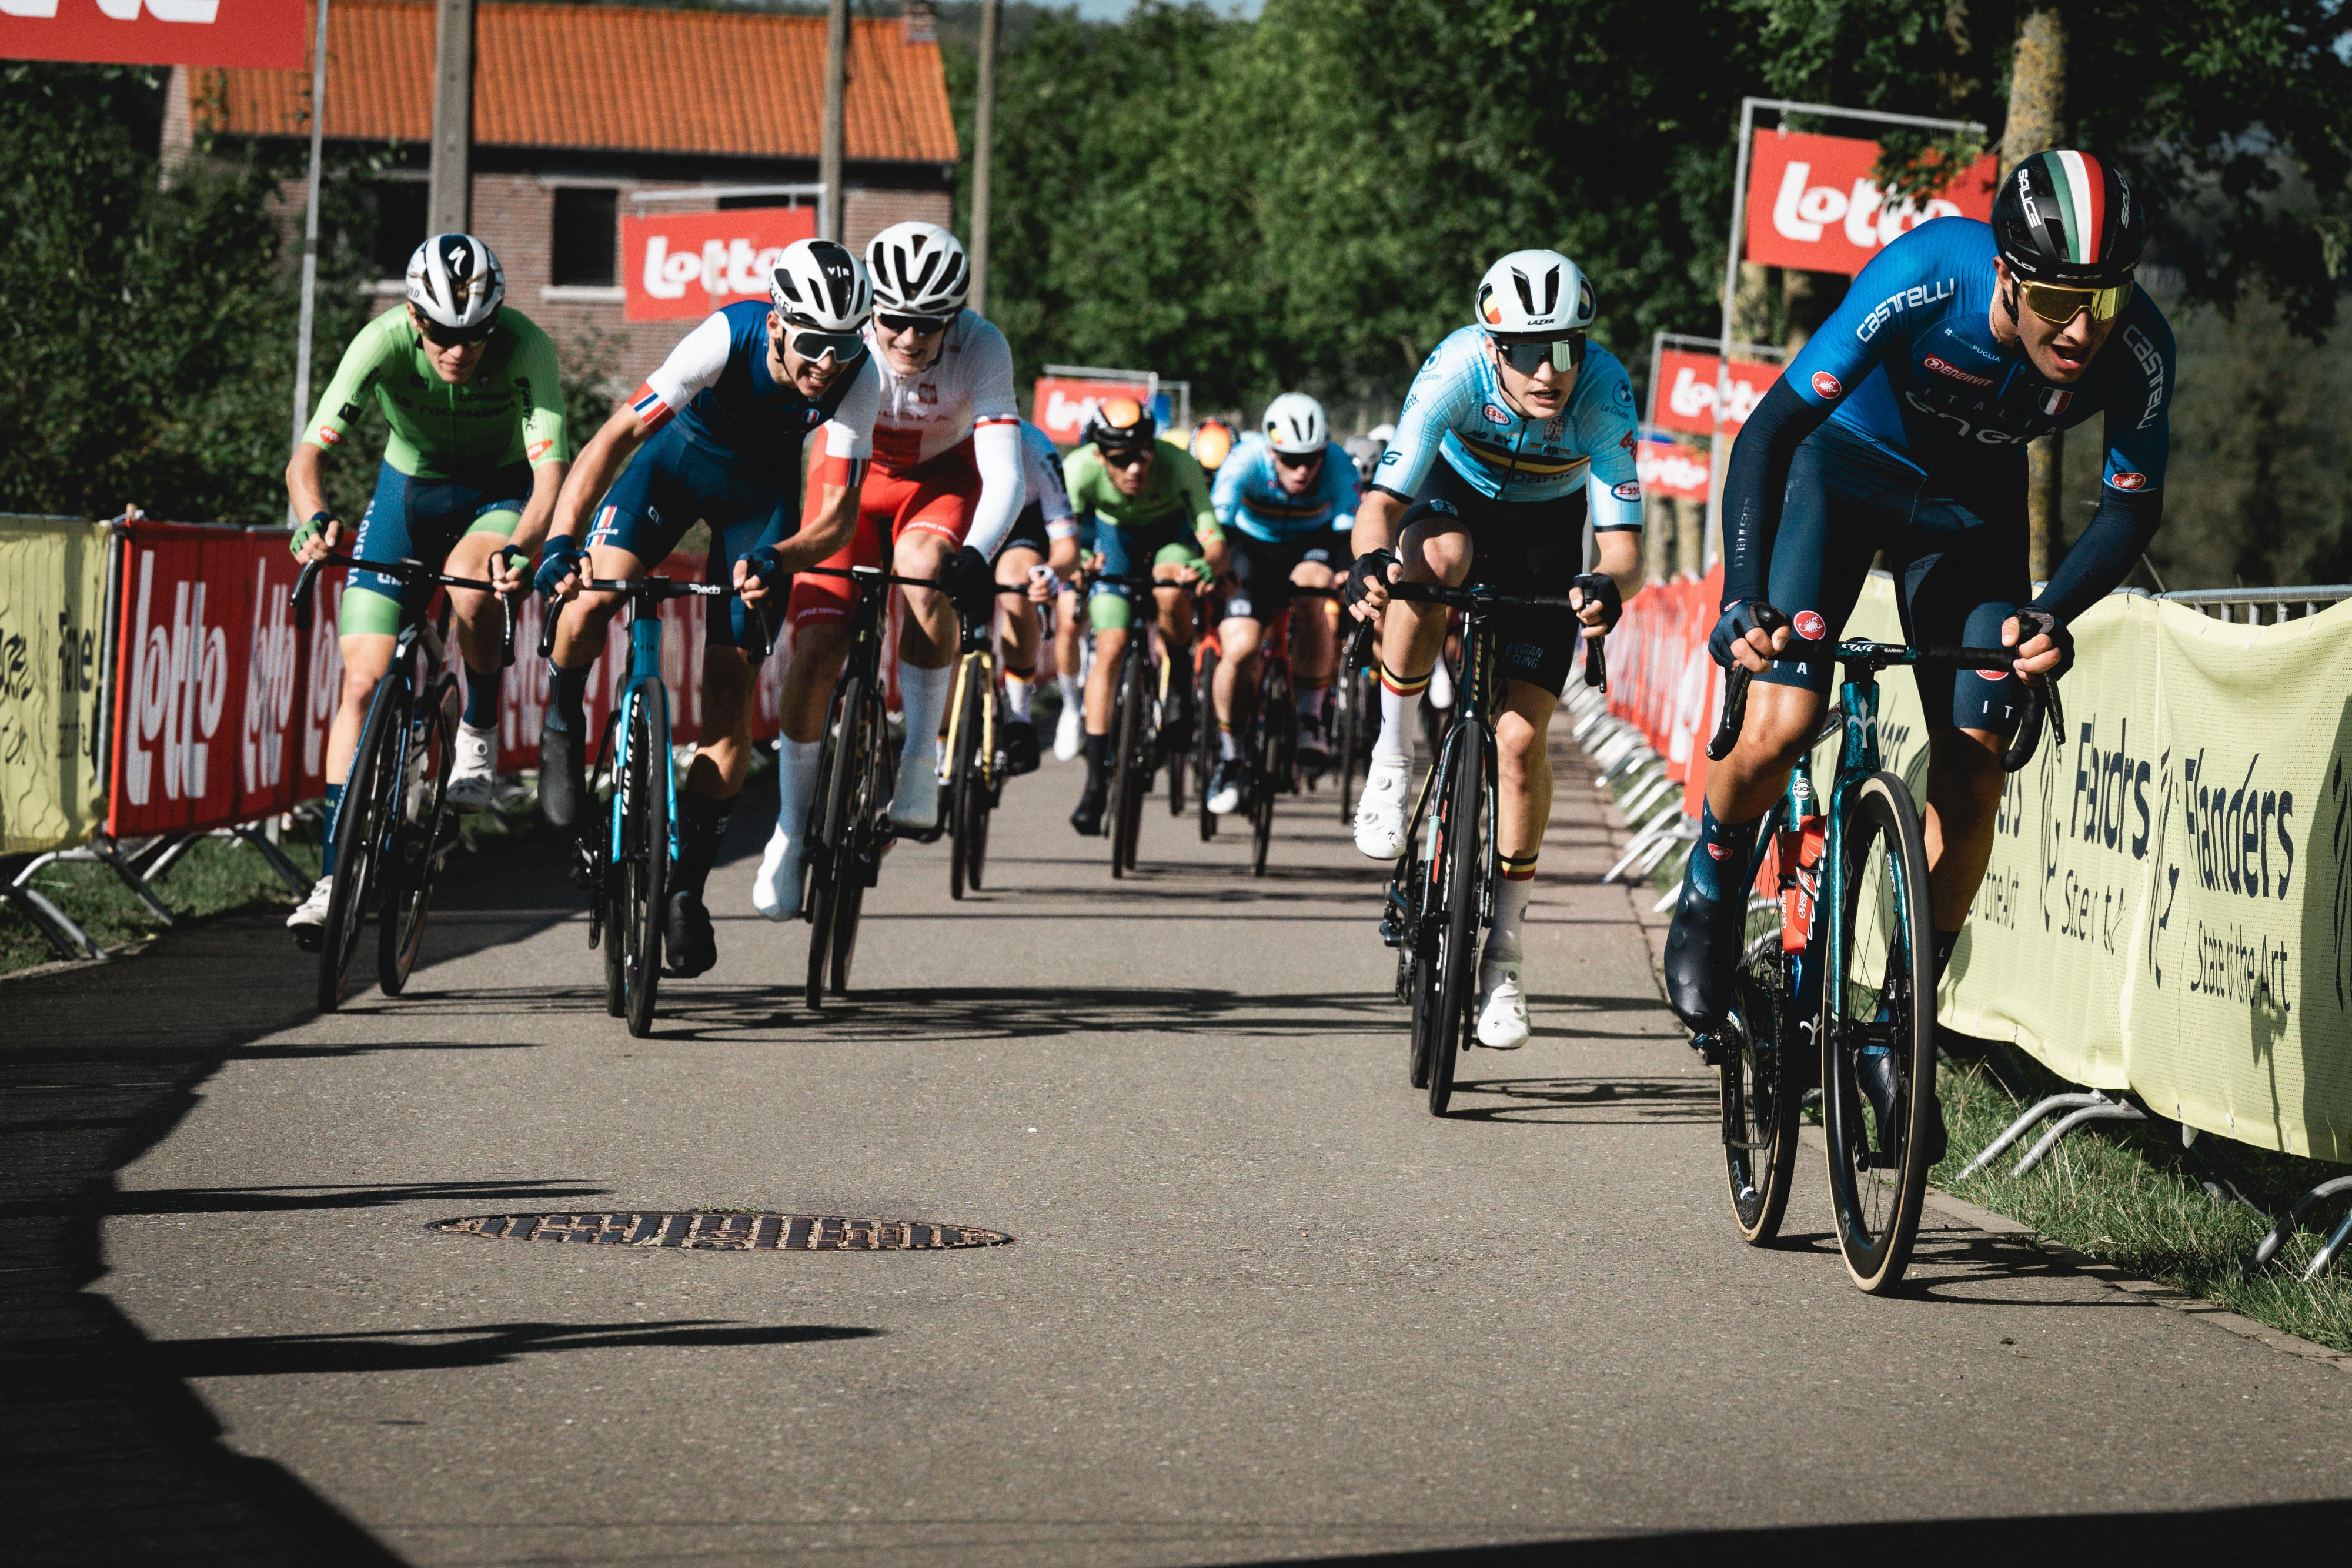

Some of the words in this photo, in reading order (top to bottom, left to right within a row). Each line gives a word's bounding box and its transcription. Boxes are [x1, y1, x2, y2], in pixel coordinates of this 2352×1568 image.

[2018, 169, 2042, 228] SALICE
[2005, 250, 2037, 273] SALICE
[1940, 365, 1994, 387] ENERVIT
[689, 583, 721, 594] Deda
[2185, 748, 2293, 900] Flanders
[2190, 919, 2224, 998] State
[2235, 924, 2255, 1008] the
[2259, 934, 2291, 1012] Art
